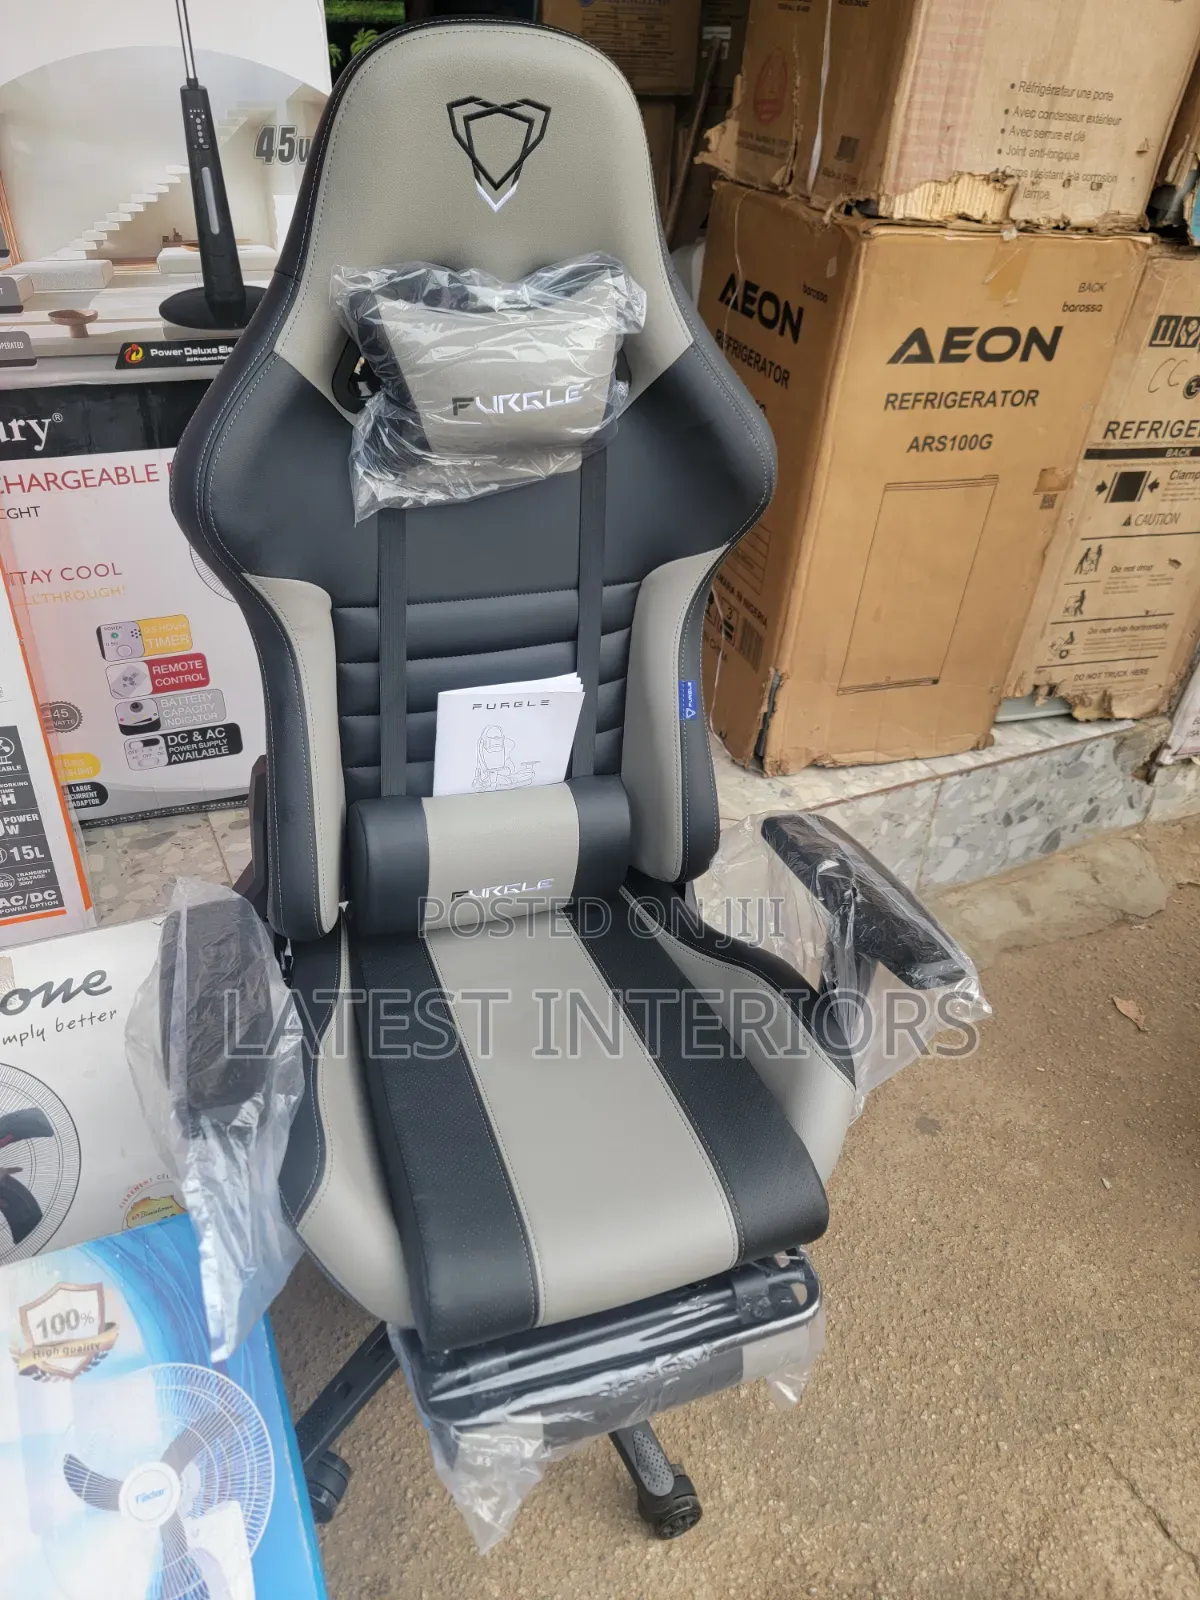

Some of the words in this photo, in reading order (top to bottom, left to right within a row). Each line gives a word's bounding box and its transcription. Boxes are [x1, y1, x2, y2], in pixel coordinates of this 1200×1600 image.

[1076, 90, 1092, 99] une
[1092, 90, 1114, 101] porte
[1012, 106, 1037, 119] Avec
[1008, 125, 1033, 138] Avec
[1063, 131, 1074, 141] et
[1005, 145, 1028, 157] Joint
[718, 271, 804, 345] AEON
[150, 348, 183, 357] Power
[184, 346, 218, 356] Deluxe
[886, 325, 1064, 364] AEON
[715, 329, 790, 390] REFRIGERATOR
[883, 389, 1040, 412] REFRIGERATOR
[1102, 419, 1200, 440] REFRIGE
[905, 433, 994, 454] ARS100G
[1165, 448, 1192, 458] BACK
[0, 463, 160, 495] HARGEABLE
[1134, 512, 1181, 527] CAUTION
[60, 562, 123, 582] COOL
[145, 633, 190, 649] TIMER
[152, 660, 204, 675] REMOTE
[1085, 672, 1102, 680] NOT
[1103, 670, 1128, 679] TRUCK
[154, 672, 207, 687] CONTROL
[160, 692, 213, 709] BATTERY
[52, 708, 69, 718] 45
[162, 703, 216, 718] CAPACITY
[164, 712, 219, 727] INDICATOR
[167, 733, 189, 746] DC
[192, 731, 203, 742] &
[206, 727, 227, 740] AC
[168, 742, 198, 753] POWER
[198, 739, 228, 748] SUPPLY
[171, 746, 230, 763] AVAILABLE
[70, 791, 98, 800] CURRENT
[72, 785, 92, 793] LARGE
[71, 798, 100, 807] ADAPTOR
[3, 813, 39, 825] POWER
[10, 845, 45, 861] 15L
[16, 868, 52, 878] TRANSIENT
[17, 874, 46, 882] VOLTAGE
[30, 900, 59, 909] OPTION
[55, 1009, 117, 1033] better
[36, 1308, 95, 1340] 100%
[33, 1347, 60, 1360] High
